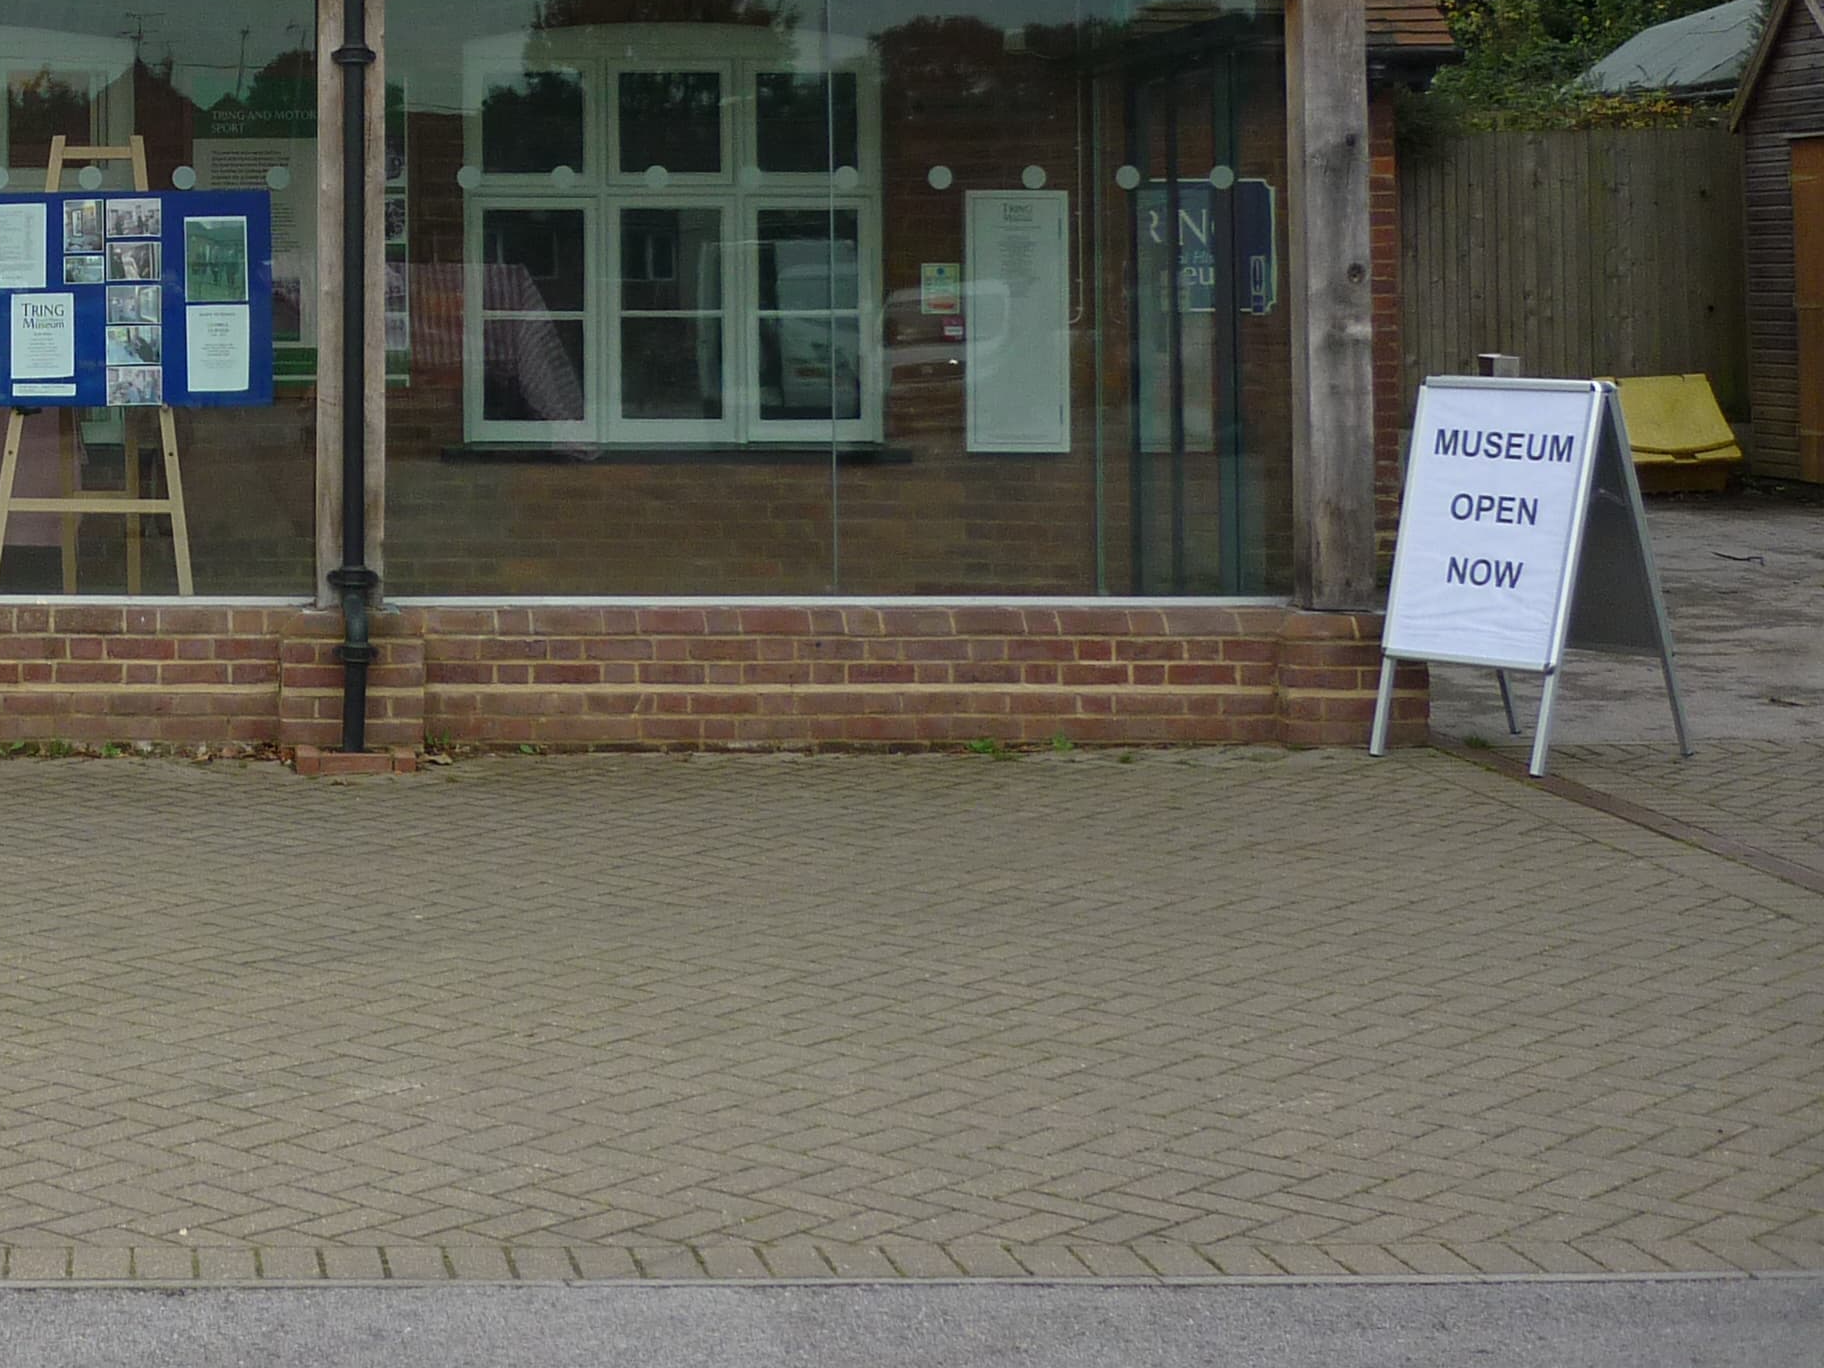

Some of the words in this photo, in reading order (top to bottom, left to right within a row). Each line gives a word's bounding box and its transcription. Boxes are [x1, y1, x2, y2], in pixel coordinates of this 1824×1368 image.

[212, 110, 245, 121] TRING
[247, 110, 273, 121] AND
[275, 110, 317, 121] MOTOR
[211, 123, 245, 134] SPORT
[21, 303, 64, 317] TRING
[22, 318, 65, 329] Museum
[1434, 428, 1574, 463] MUSEUM
[1450, 493, 1539, 526] OPEN
[1446, 556, 1523, 589] NOW
